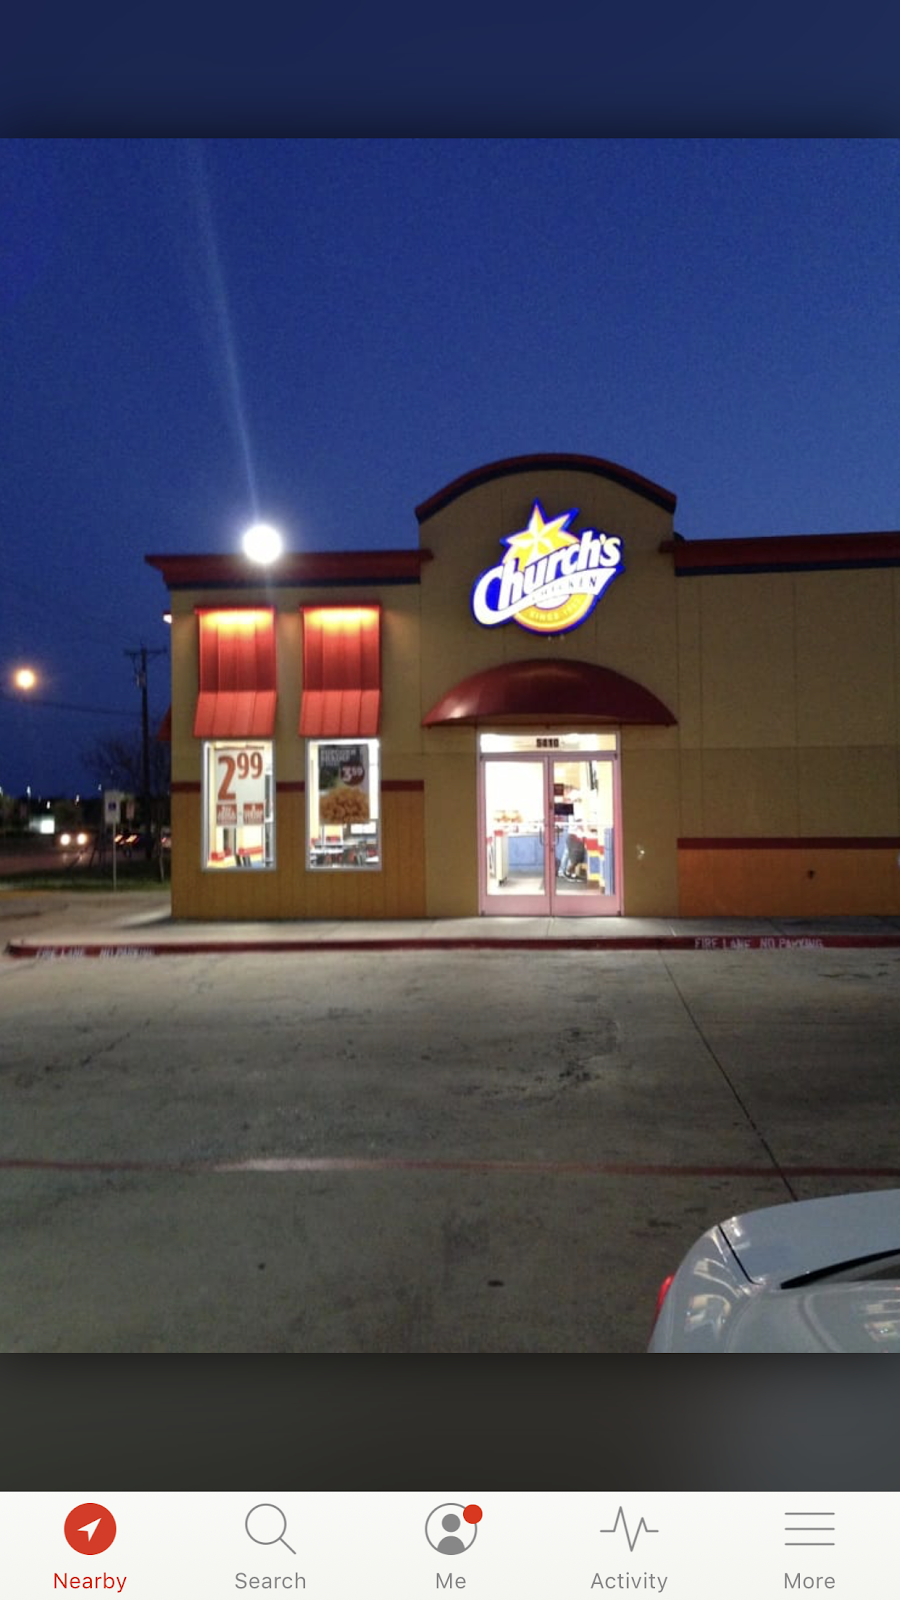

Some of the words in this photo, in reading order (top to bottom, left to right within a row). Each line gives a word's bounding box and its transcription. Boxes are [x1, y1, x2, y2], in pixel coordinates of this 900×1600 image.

[473, 530, 621, 625] Church's
[695, 938, 717, 949] FIRE
[722, 938, 750, 949] LANE
[760, 938, 775, 949] NO
